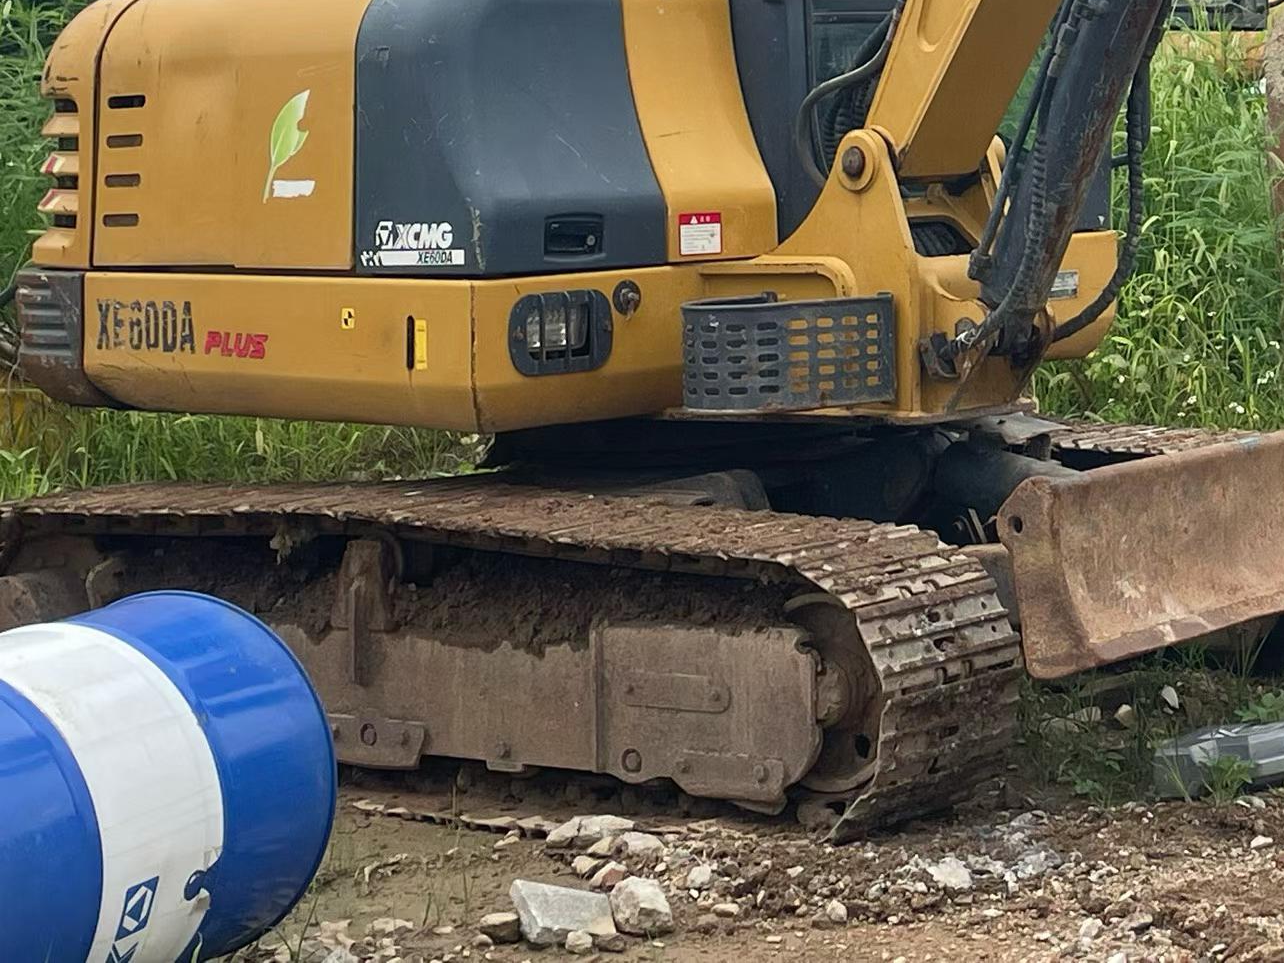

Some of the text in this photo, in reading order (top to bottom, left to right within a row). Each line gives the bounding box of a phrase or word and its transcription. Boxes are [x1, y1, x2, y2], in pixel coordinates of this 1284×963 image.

[393, 222, 453, 249] XCMG
[416, 251, 453, 264] XE60DA
[204, 330, 269, 360] PLUS
